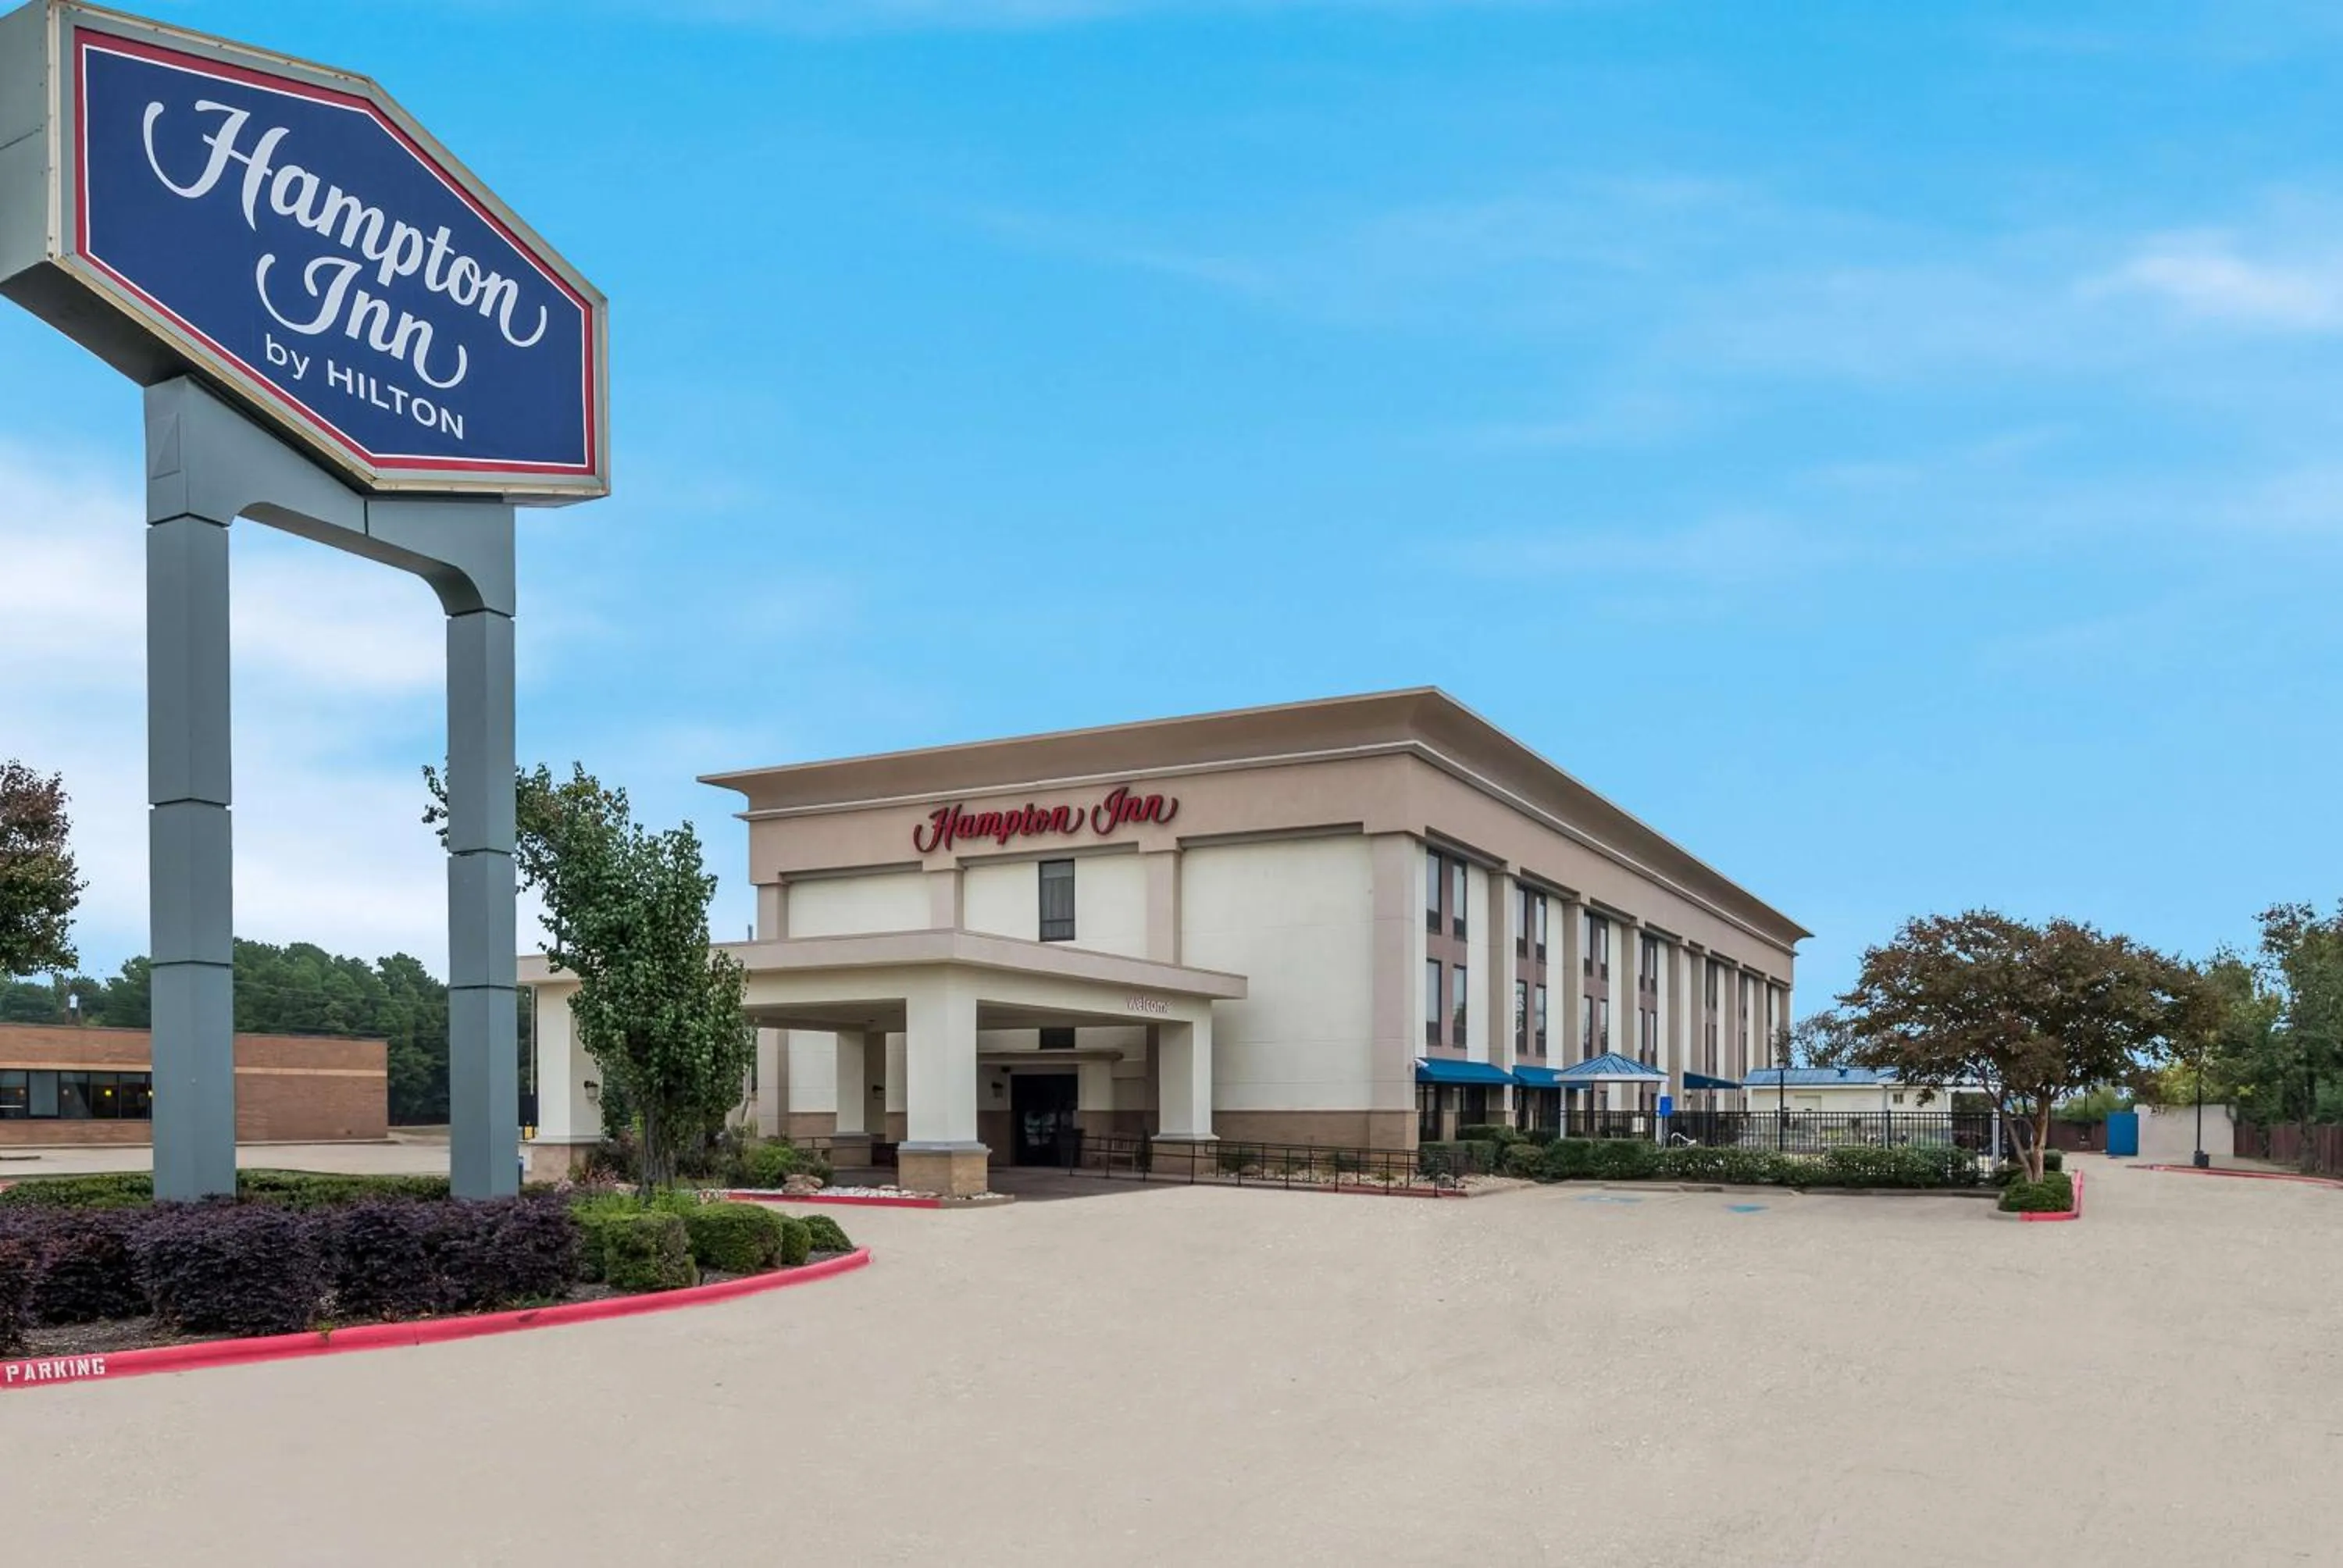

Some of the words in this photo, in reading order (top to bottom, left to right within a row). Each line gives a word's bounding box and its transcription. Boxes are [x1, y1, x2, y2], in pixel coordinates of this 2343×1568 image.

[143, 100, 547, 347] Hampton
[257, 255, 468, 389] Inn
[266, 333, 309, 380] by
[327, 359, 463, 440] HILTON
[913, 803, 1085, 853] Hampton
[1090, 786, 1179, 836] Inn
[5, 1357, 105, 1382] PARKING
